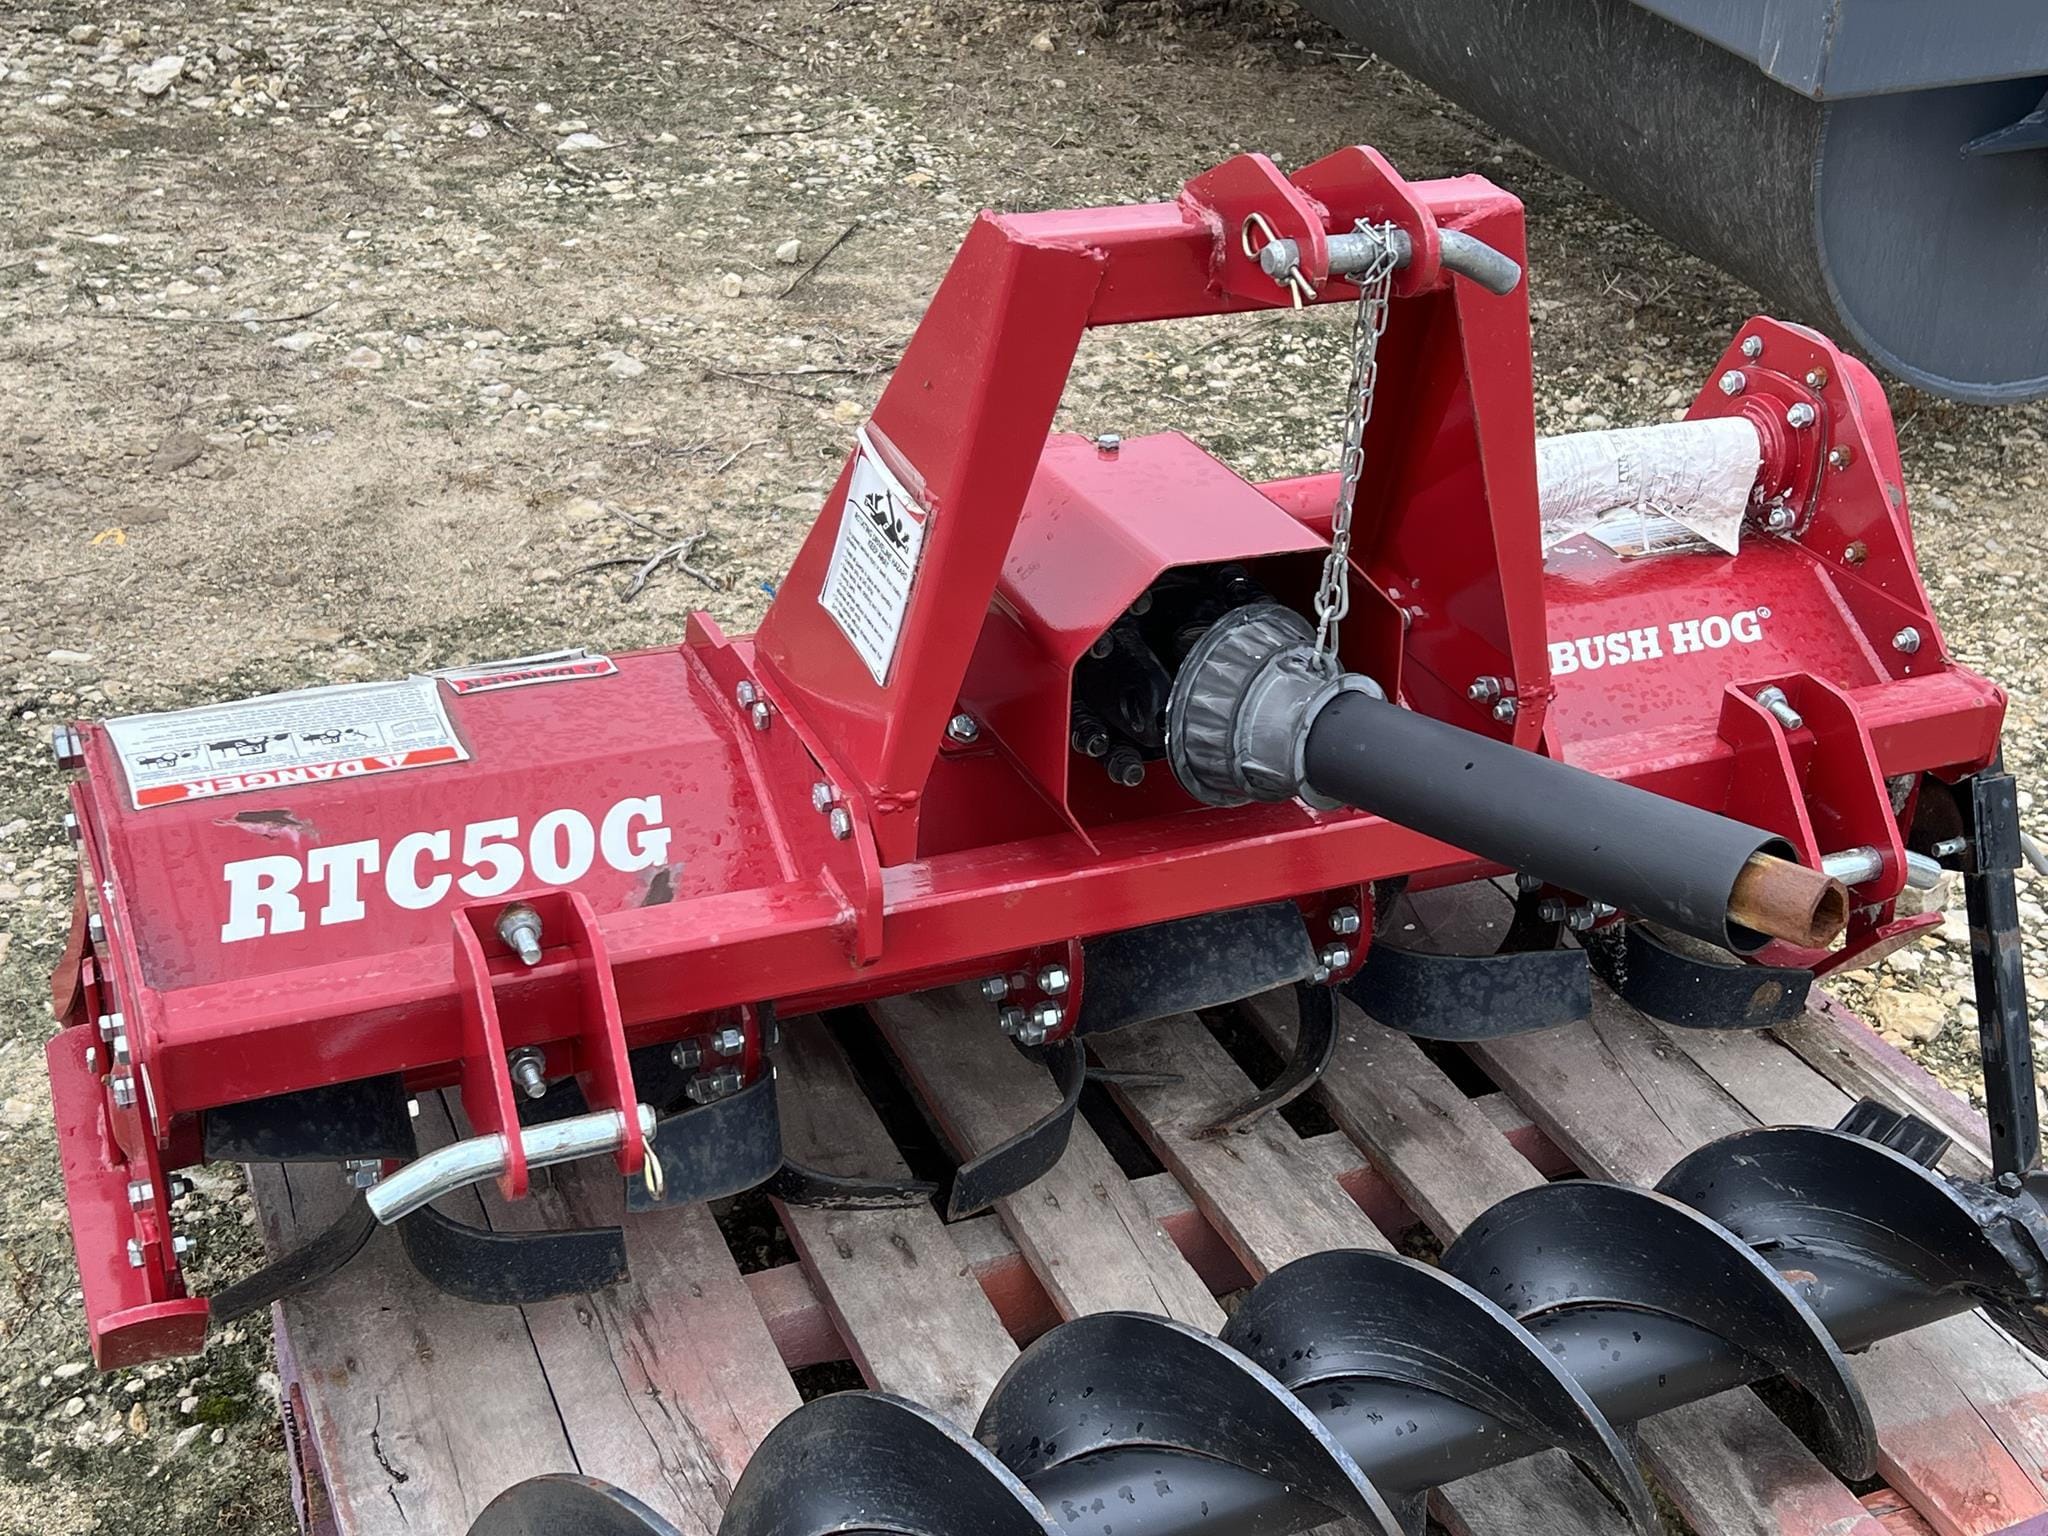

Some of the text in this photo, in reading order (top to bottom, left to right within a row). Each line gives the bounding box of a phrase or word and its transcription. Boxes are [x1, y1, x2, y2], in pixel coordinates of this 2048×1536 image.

[1547, 626, 1663, 676] BUSH
[465, 668, 576, 689] DANGER
[183, 758, 367, 800] DANGER
[220, 795, 672, 943] RTC50G
